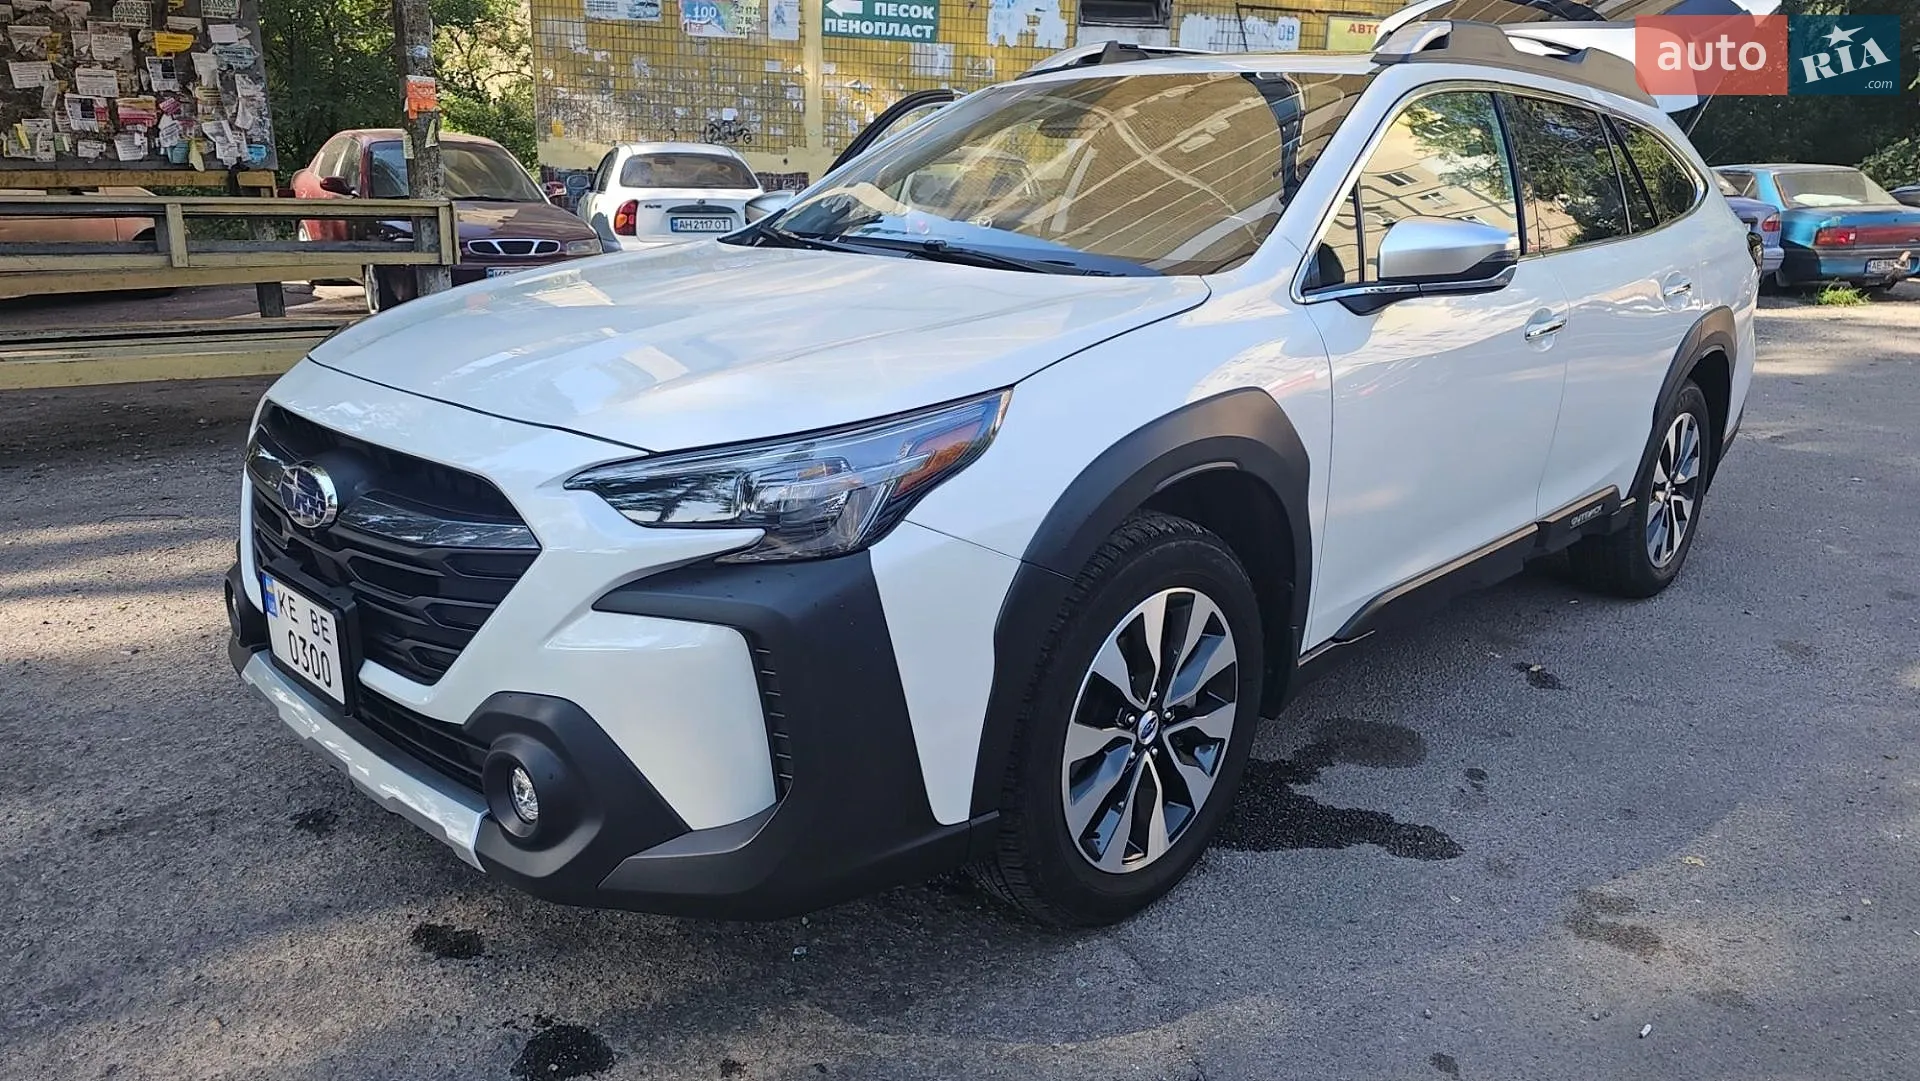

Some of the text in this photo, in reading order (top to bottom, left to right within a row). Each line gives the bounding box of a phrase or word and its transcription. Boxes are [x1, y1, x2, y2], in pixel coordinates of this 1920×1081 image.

[693, 6, 717, 18] 100
[874, 2, 935, 19] ПЕСОК
[824, 18, 935, 39] ПЕНОПЛАСТ
[679, 220, 692, 229] AH
[277, 589, 332, 646] KE BE
[288, 629, 332, 688] 0300
